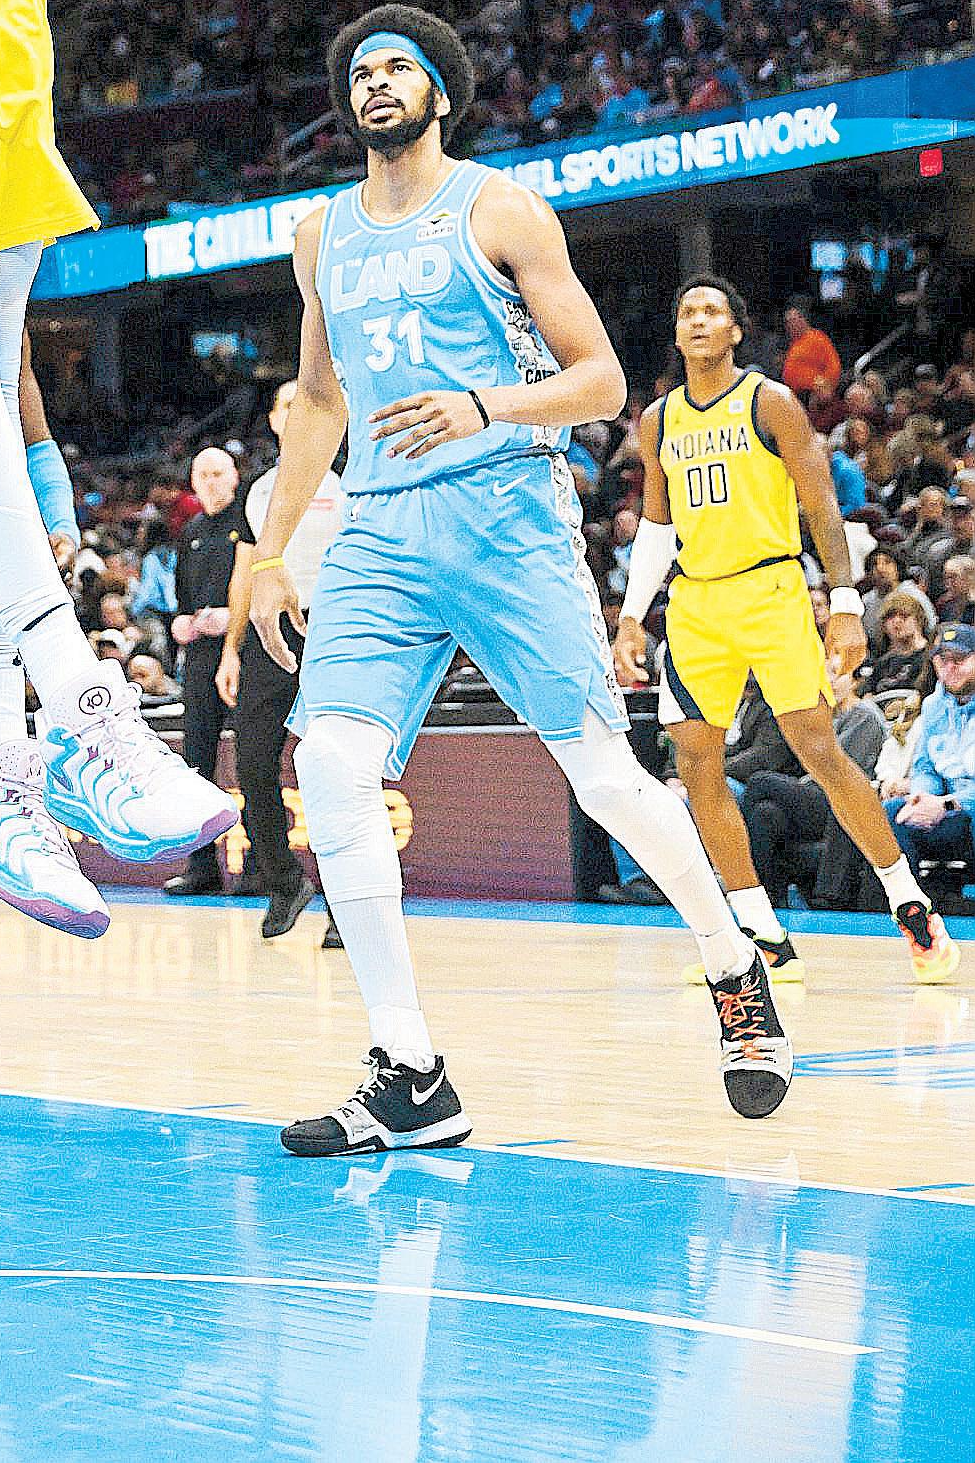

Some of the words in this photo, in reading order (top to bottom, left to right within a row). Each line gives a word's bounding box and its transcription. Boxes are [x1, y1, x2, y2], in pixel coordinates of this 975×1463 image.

[560, 134, 681, 194] SPORTS
[681, 102, 841, 172] NETWORK
[329, 243, 453, 315] LAND
[362, 309, 426, 373] 31
[664, 426, 750, 463] NDIANA
[687, 462, 728, 508] 00
